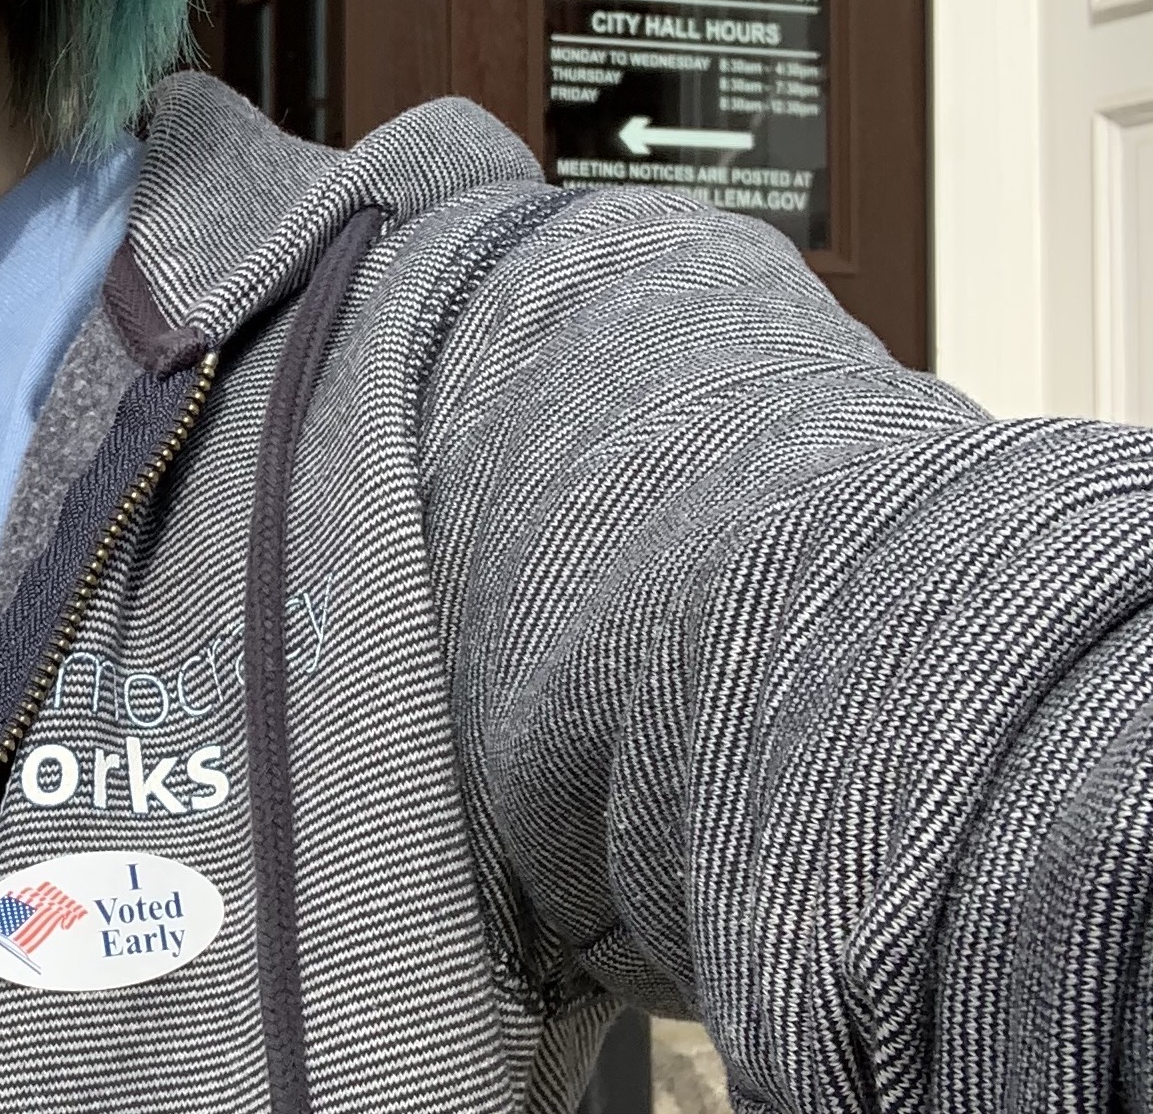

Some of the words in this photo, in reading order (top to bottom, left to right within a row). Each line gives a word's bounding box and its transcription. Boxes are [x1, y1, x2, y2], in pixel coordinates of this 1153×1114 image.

[591, 10, 642, 35] CITY
[645, 13, 701, 40] HALL
[705, 18, 783, 46] HOURS
[551, 47, 608, 64] MONDAY
[610, 51, 628, 66] TO
[630, 52, 712, 71] WEDNESDAY
[552, 67, 624, 85] THURSDAY
[551, 86, 598, 103] FRIDAY
[557, 158, 626, 179] MEETING
[629, 163, 696, 183] NOTICES
[698, 166, 730, 185] ARE
[731, 167, 791, 187] POSTED
[793, 170, 814, 189] AT
[126, 862, 142, 892] I
[93, 890, 185, 926] Voted
[100, 925, 187, 959] Early
